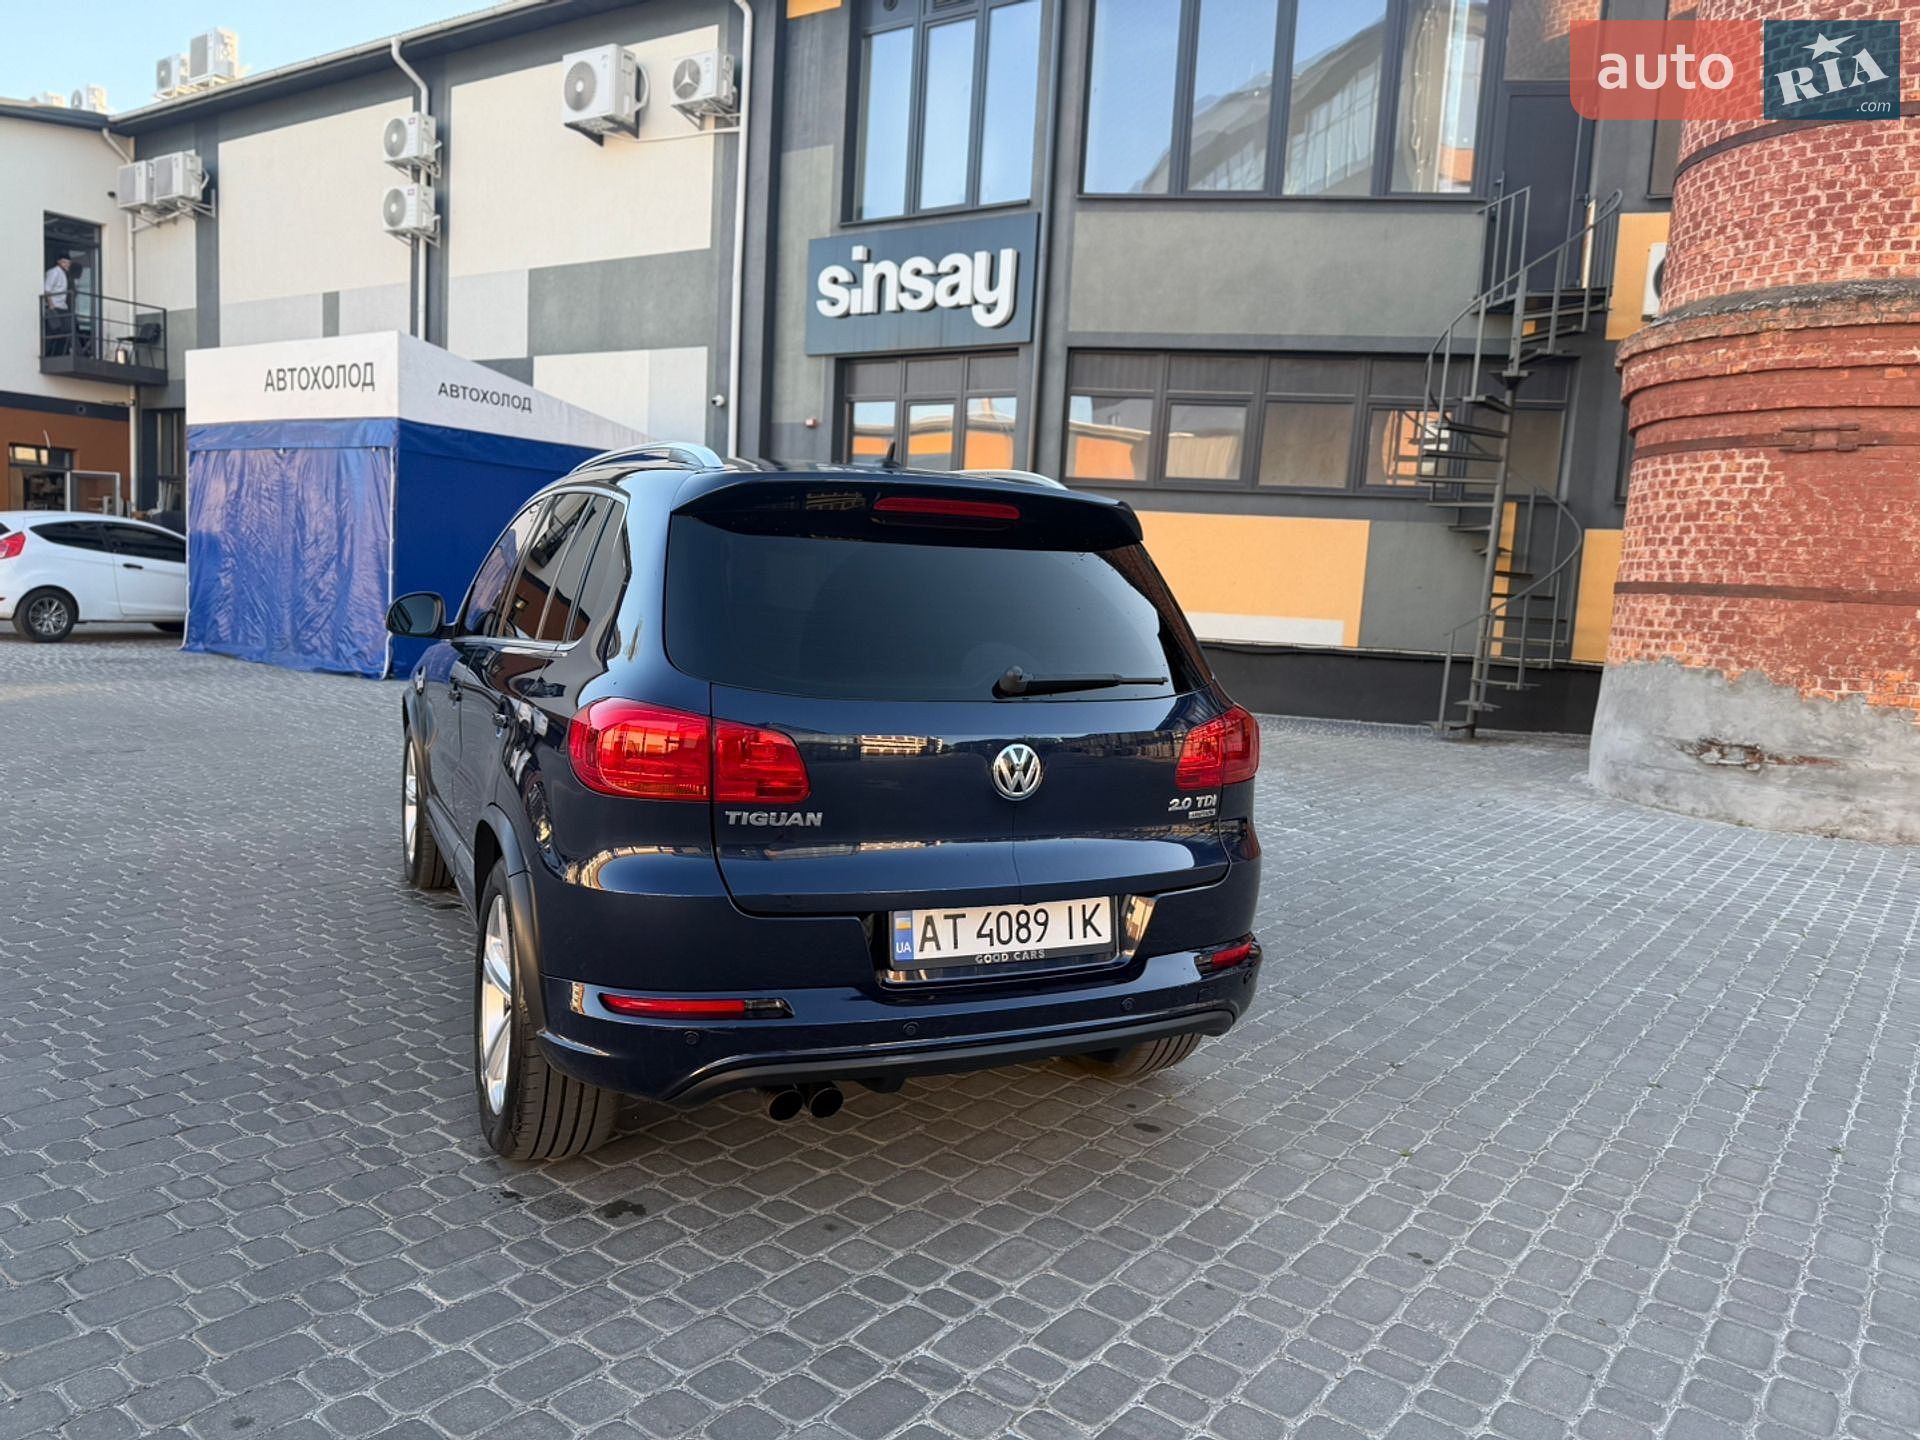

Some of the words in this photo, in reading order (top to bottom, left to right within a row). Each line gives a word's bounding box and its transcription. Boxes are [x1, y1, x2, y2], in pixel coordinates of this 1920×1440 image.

[816, 245, 1017, 327] sinsay
[264, 362, 376, 392] АВТОХОЛОД
[438, 382, 533, 413] АВТОХОЛОД
[1196, 794, 1217, 808] TDI
[725, 811, 823, 827] TIGUAN
[919, 913, 966, 953] AT
[976, 908, 1049, 947] 4089
[1067, 903, 1102, 940] IK
[896, 942, 911, 954] UA
[975, 952, 1010, 964] GOOD
[1013, 949, 1046, 961] CARS
